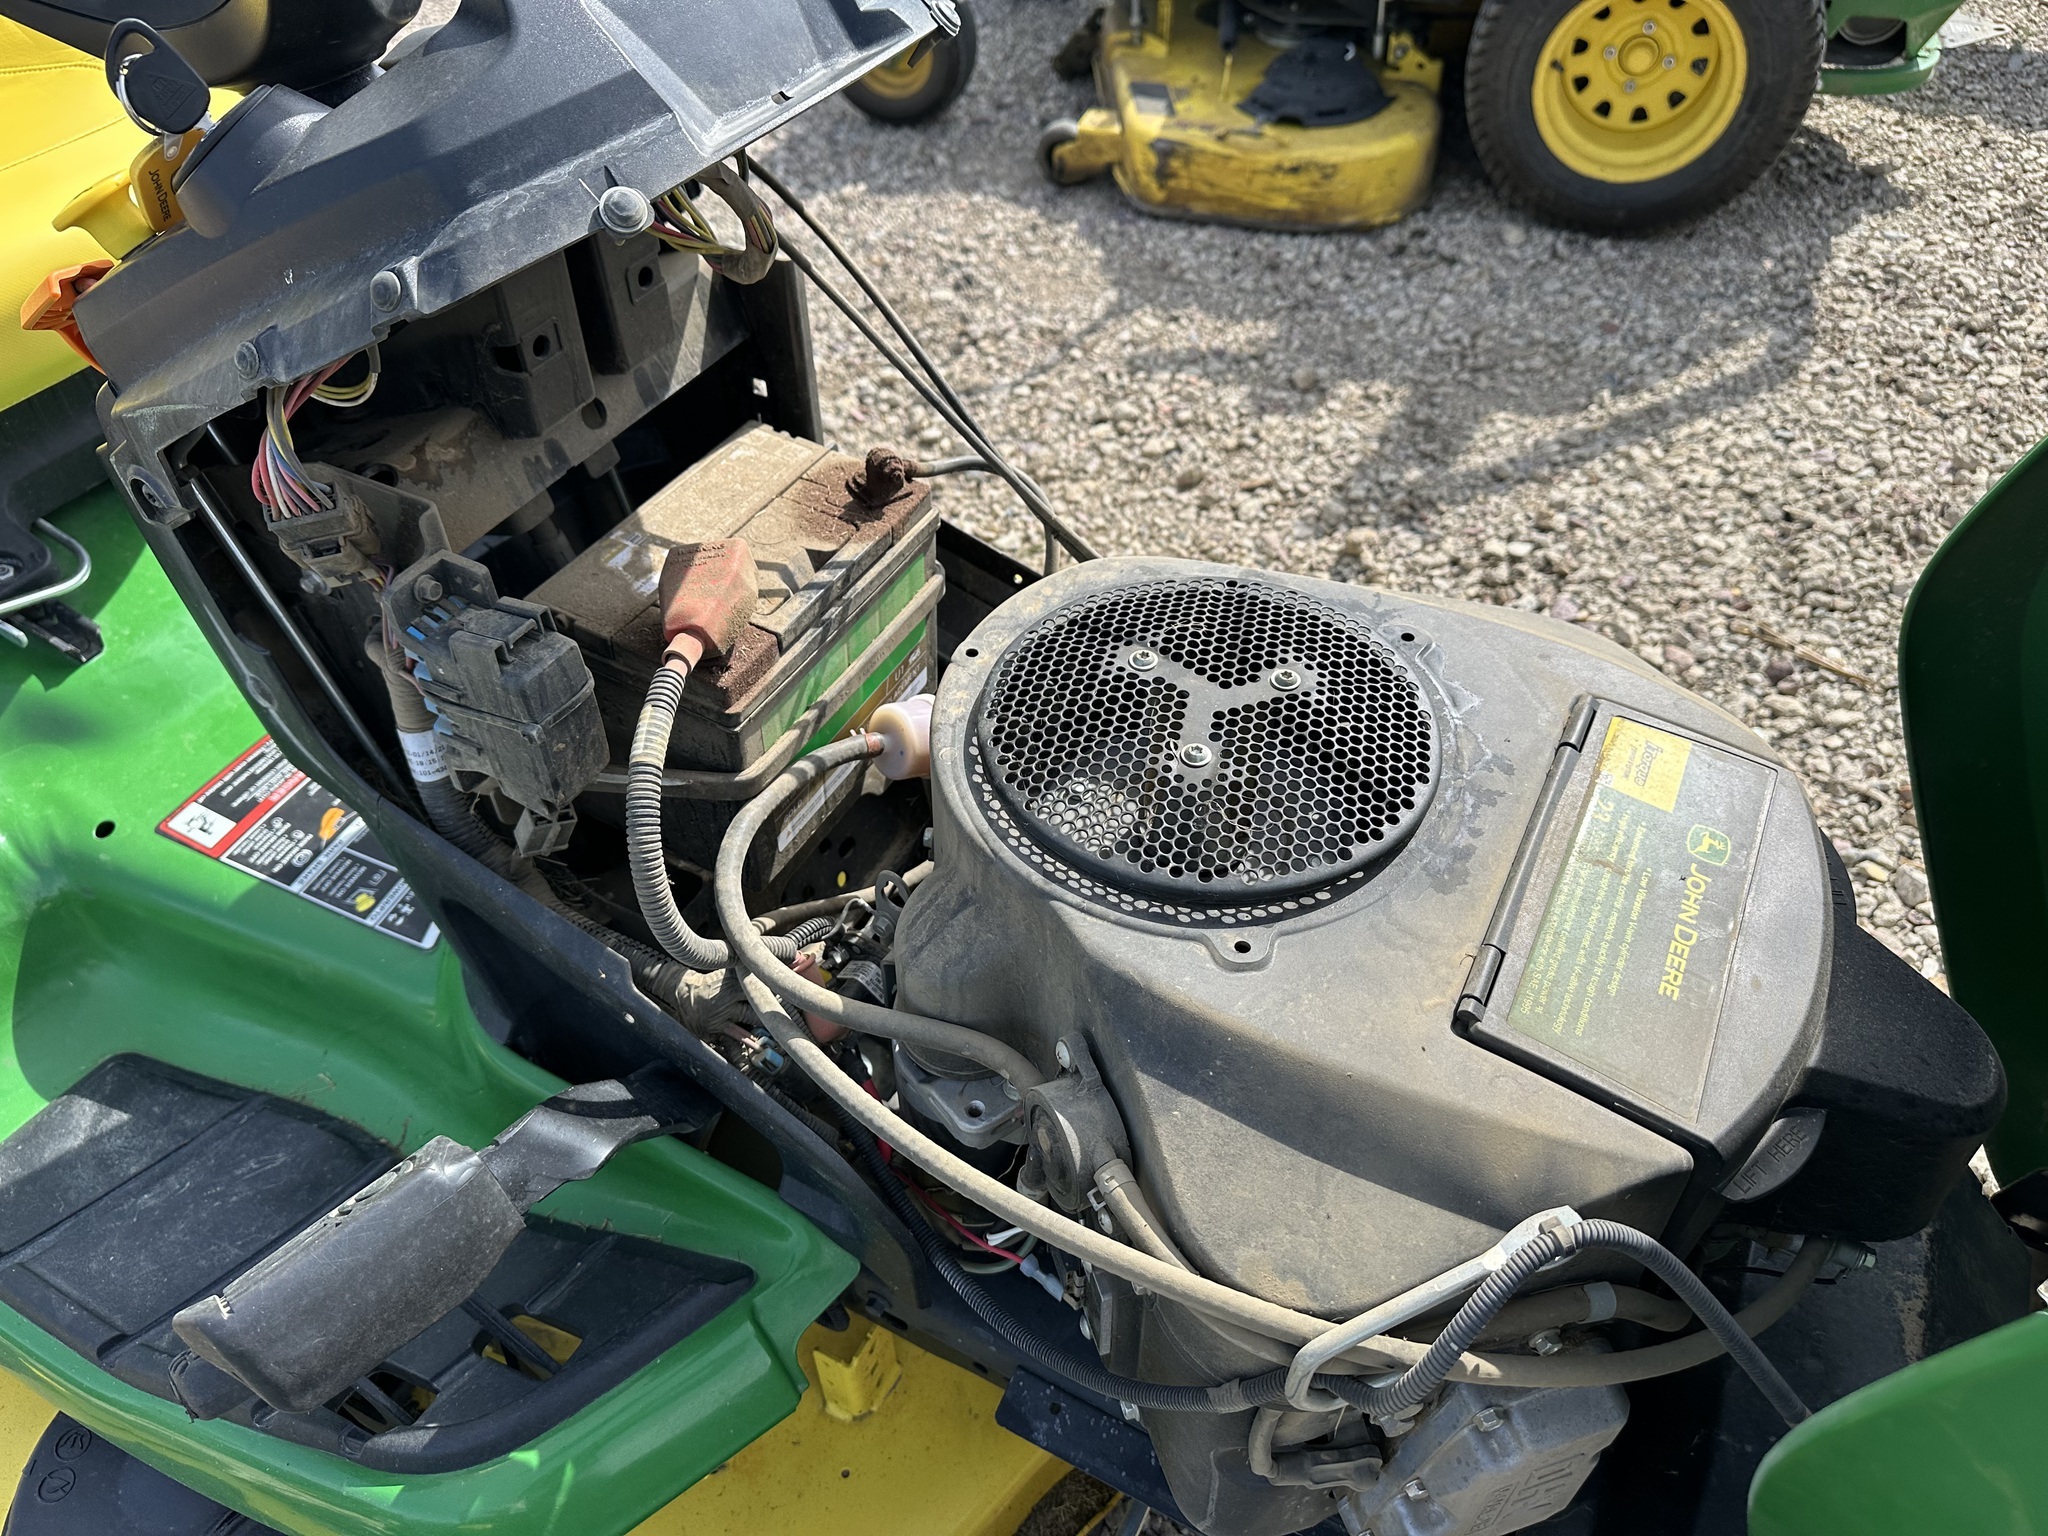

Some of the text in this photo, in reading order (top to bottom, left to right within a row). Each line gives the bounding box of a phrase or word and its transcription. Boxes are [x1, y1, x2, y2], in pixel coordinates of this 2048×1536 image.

[149, 169, 173, 221] JOHN DEERE
[1633, 741, 1663, 788] iTorque
[1628, 825, 1646, 860] Enhanced
[1639, 871, 1651, 888] Low
[1613, 885, 1628, 909] control
[1629, 887, 1647, 922] Vibration
[1658, 863, 1712, 1002] JOHN DEERE
[1593, 939, 1611, 968] quickly
[1613, 941, 1631, 972] cylinder
[1528, 970, 1541, 990] SAE
[1543, 957, 1559, 982] gross
[1605, 969, 1622, 997] design
[1535, 978, 1552, 1005] power
[1584, 973, 1600, 998] tough
[1519, 988, 1535, 1016] J1995
[1550, 990, 1574, 1036] technology
[1574, 996, 1594, 1038] conditions
[1733, 1125, 1808, 1194] LIFT HERE
